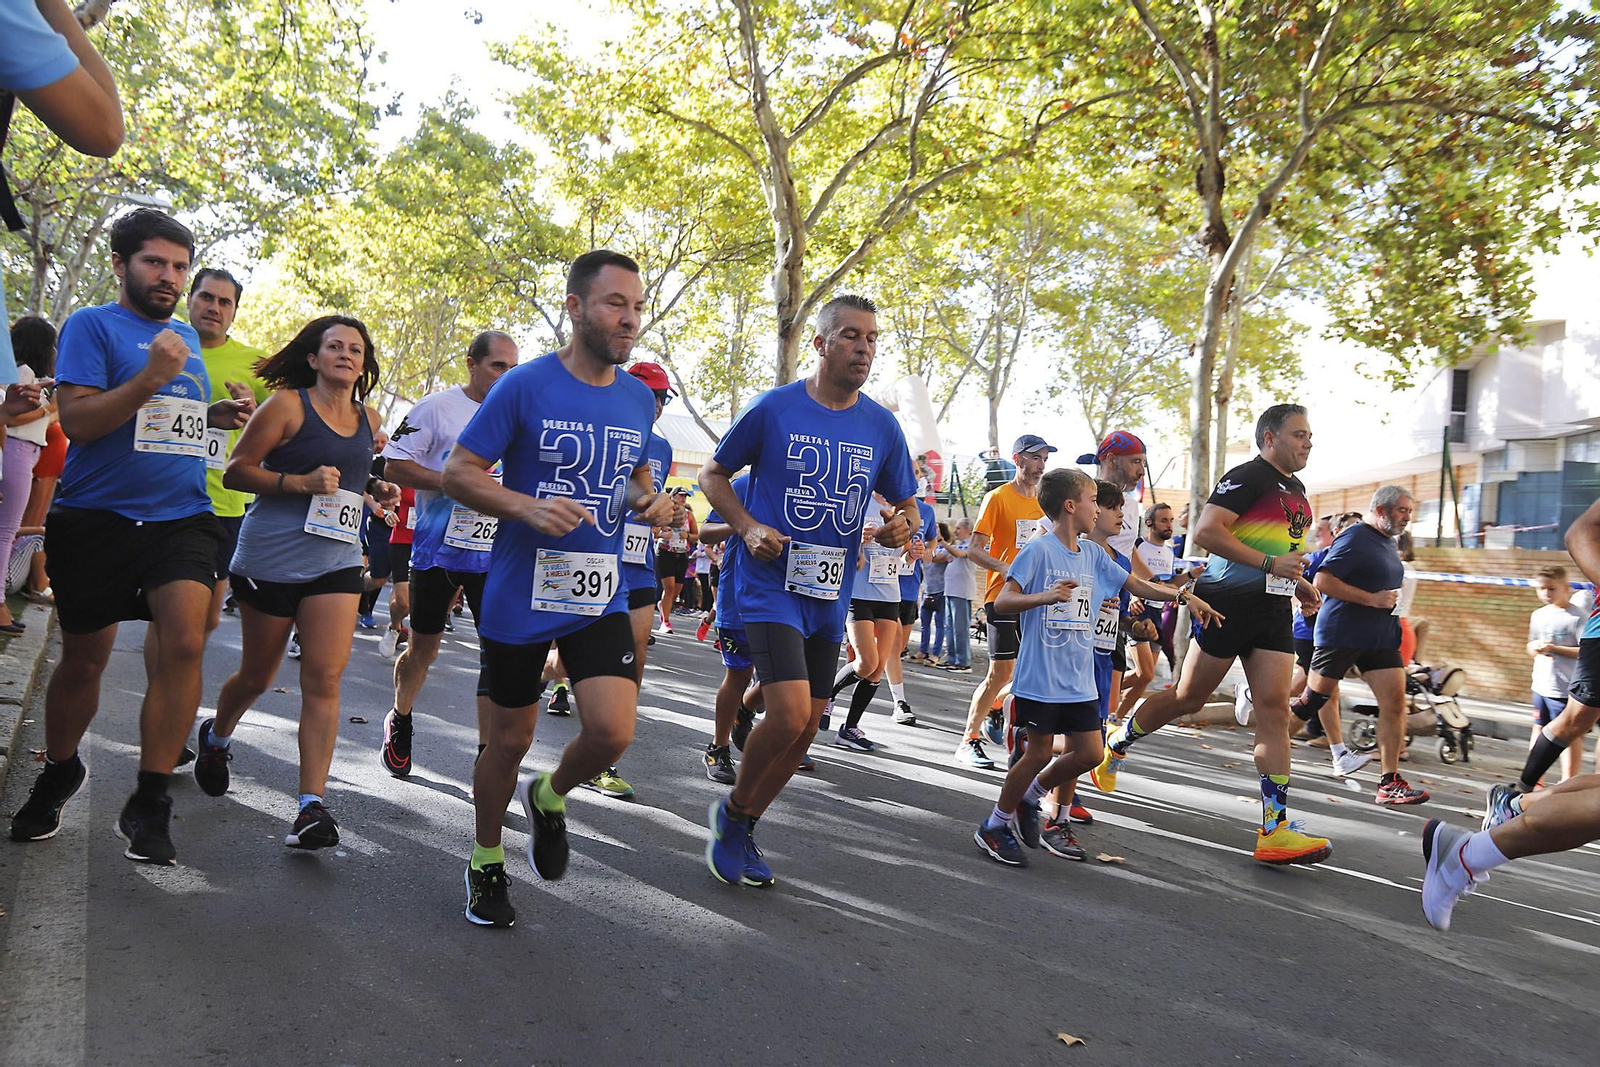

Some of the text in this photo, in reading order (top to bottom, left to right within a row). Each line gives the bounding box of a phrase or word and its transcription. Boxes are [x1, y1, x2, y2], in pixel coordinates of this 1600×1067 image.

[171, 414, 204, 440] 439
[542, 419, 595, 433] VUELTA A
[789, 433, 830, 447] VUELTA A
[539, 481, 568, 492] HUELVA
[785, 487, 810, 496] HUELVA
[339, 505, 361, 530] 630
[625, 534, 648, 553] 577
[550, 563, 570, 571] VUELTA
[586, 557, 604, 565] OSCAR
[887, 564, 897, 576] 54
[1046, 568, 1070, 578] VUELTA
[571, 570, 612, 598] 391
[1077, 598, 1089, 618] 79
[1094, 618, 1117, 639] 544
